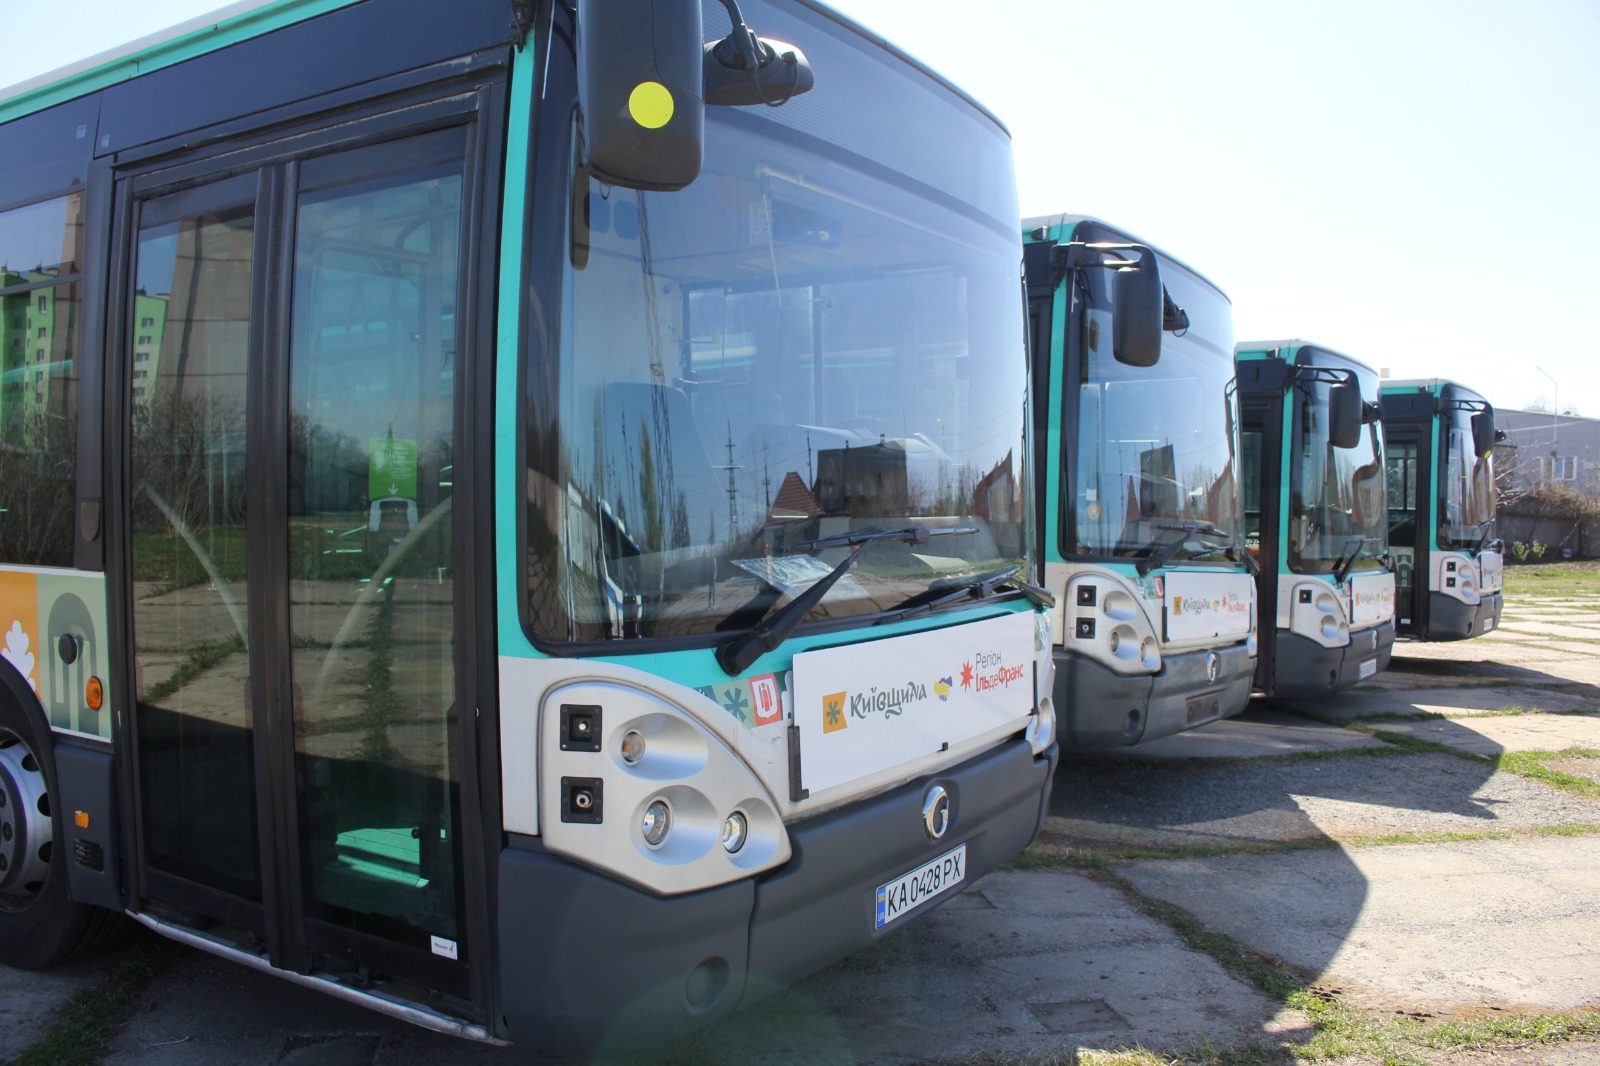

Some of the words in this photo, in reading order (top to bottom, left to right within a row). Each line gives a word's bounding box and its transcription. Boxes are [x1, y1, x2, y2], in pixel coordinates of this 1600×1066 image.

[975, 650, 1002, 671] Регіон
[850, 681, 928, 720] Київщина
[888, 882, 908, 917] KA
[910, 864, 941, 903] 0428
[943, 852, 962, 886] PX
